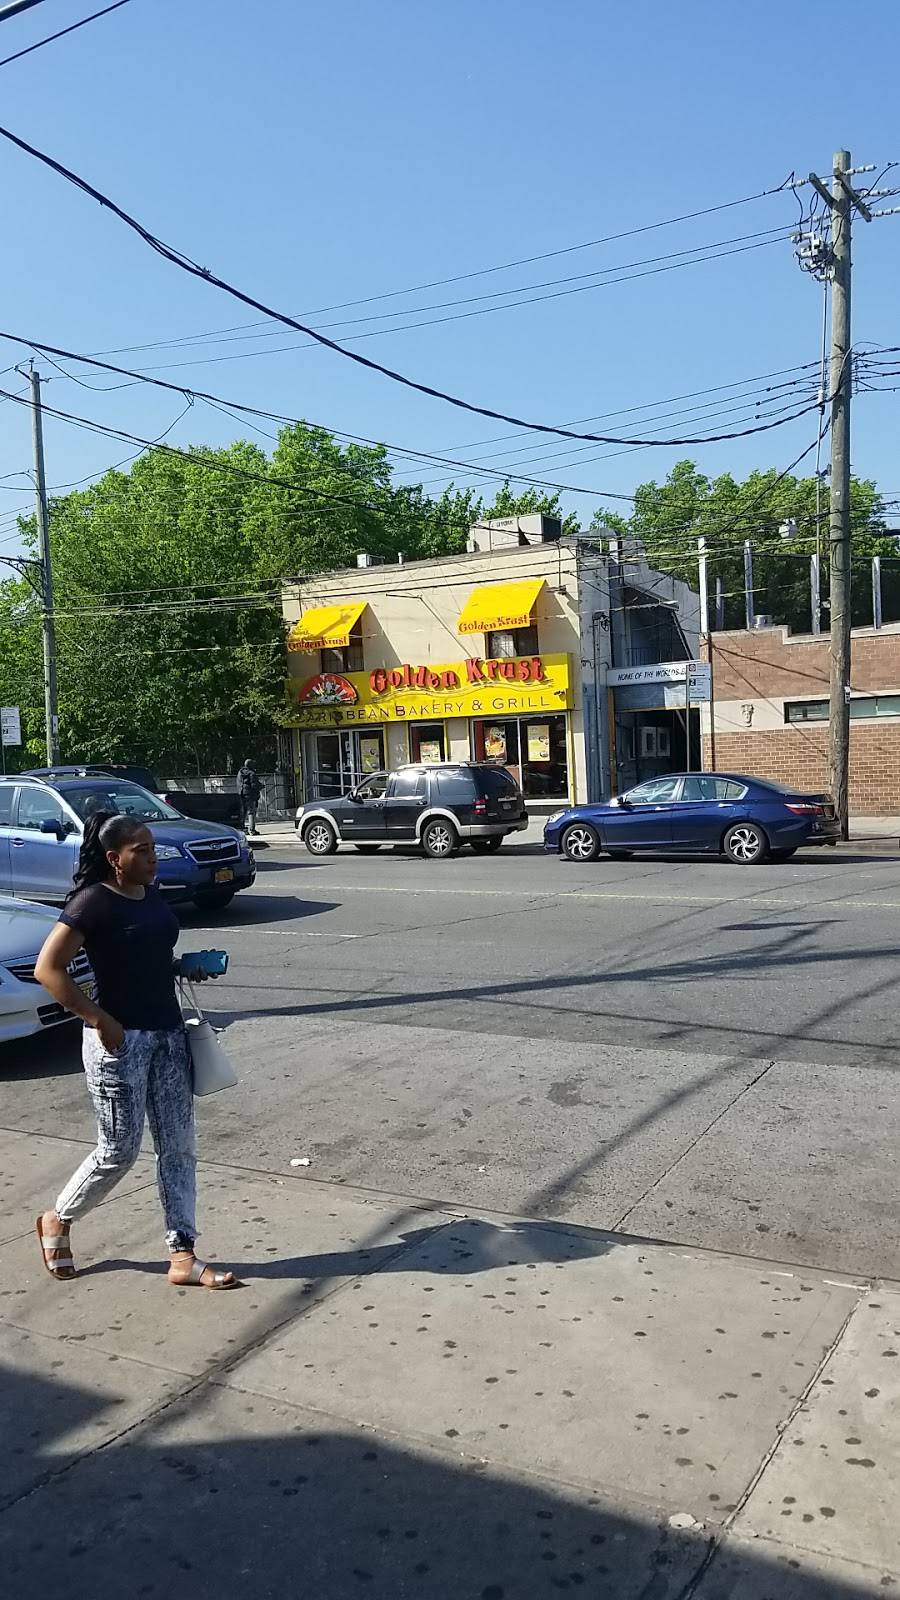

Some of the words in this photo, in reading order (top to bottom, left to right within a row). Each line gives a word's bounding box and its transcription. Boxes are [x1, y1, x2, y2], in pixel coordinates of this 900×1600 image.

[458, 621, 496, 633] Golden
[497, 614, 528, 627] Krust
[369, 664, 457, 693] Golden
[465, 656, 545, 682] Krust
[617, 672, 633, 681] HOME
[634, 671, 642, 680] OF
[644, 670, 653, 678] THE
[395, 701, 464, 718] BAKERY
[471, 699, 483, 711] &
[491, 696, 550, 710] GRILL
